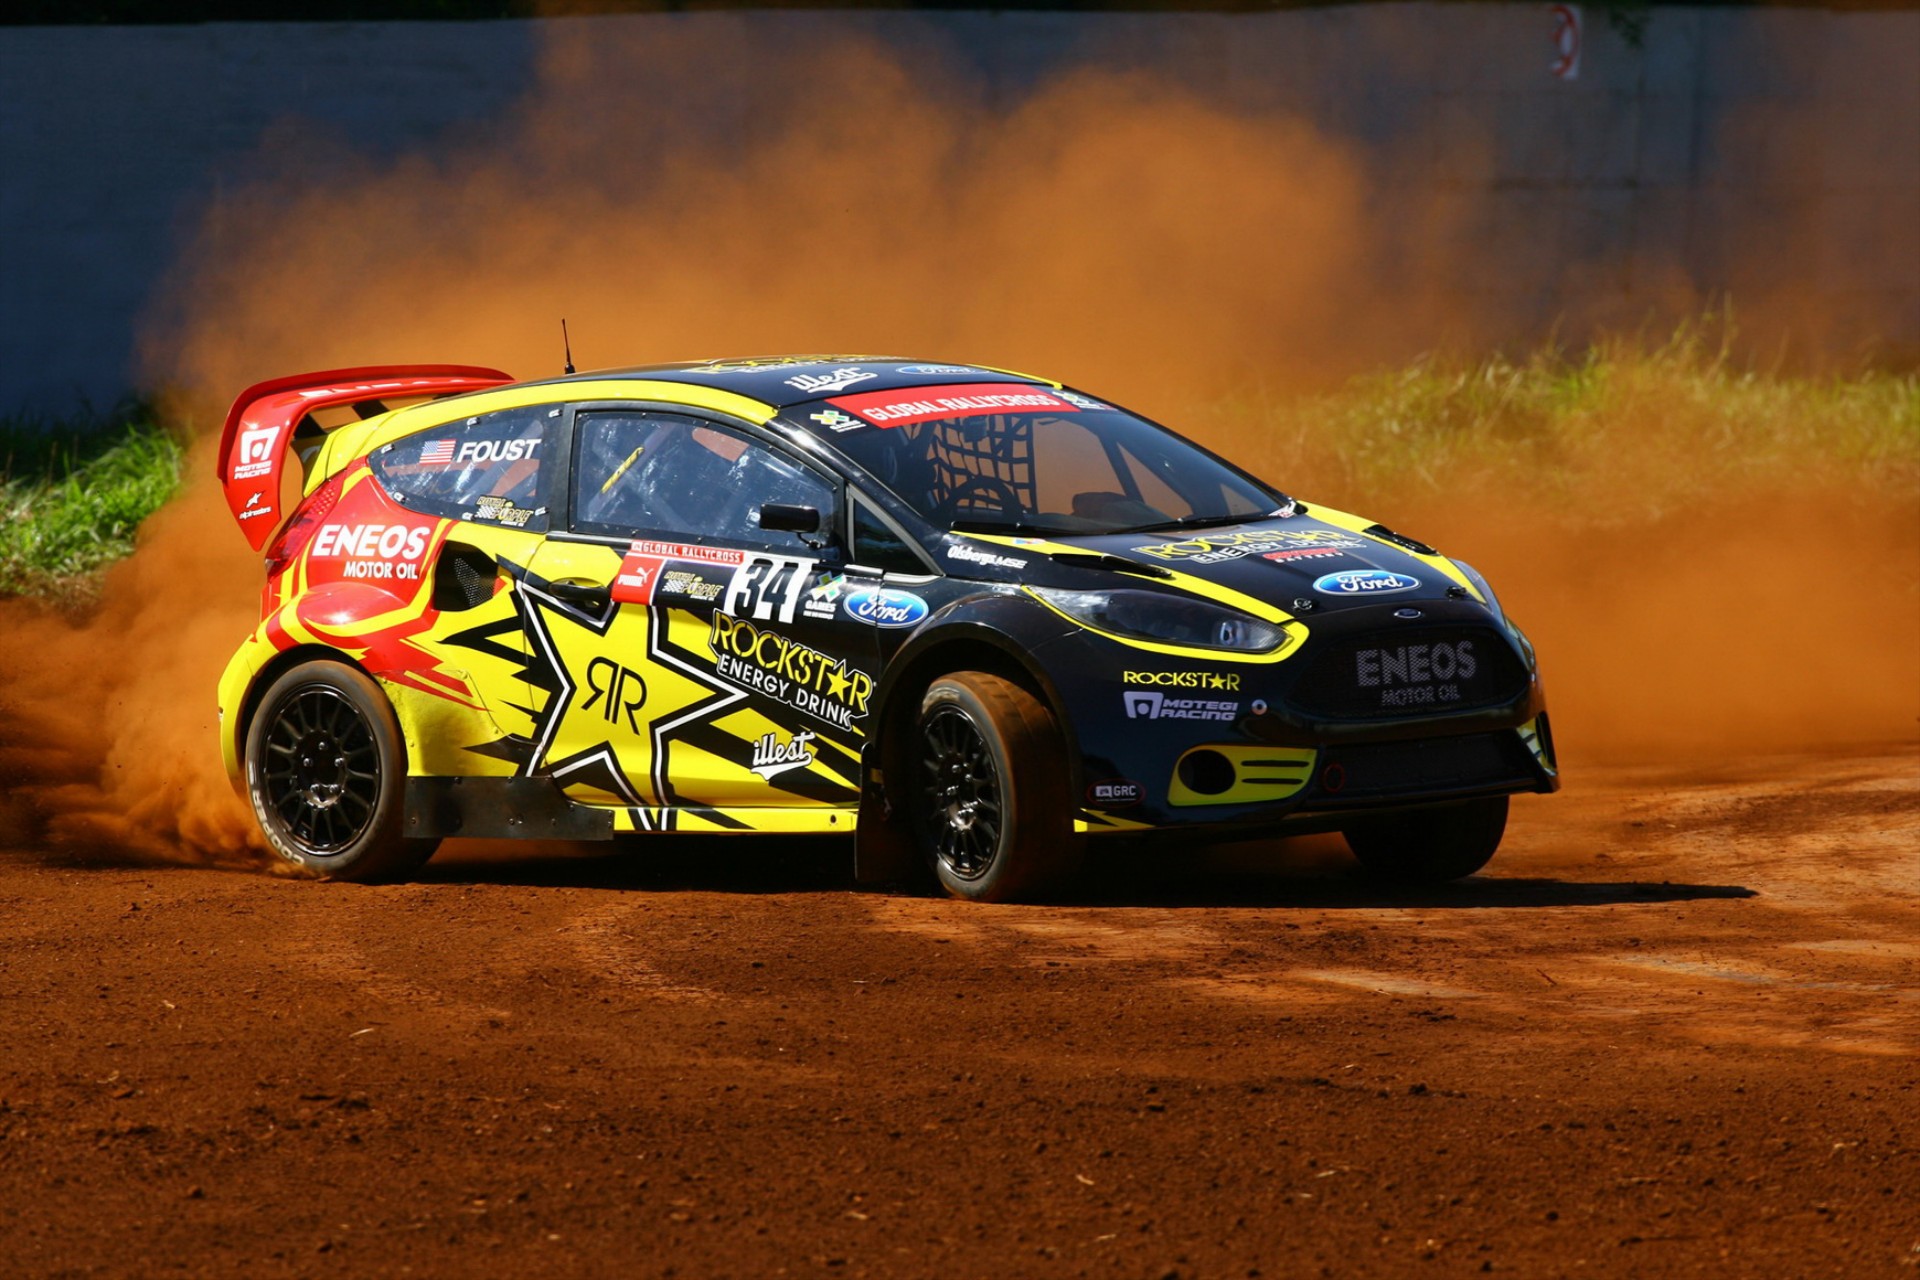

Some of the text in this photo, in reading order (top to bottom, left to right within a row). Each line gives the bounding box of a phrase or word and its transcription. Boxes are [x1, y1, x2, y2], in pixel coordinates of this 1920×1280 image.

[862, 399, 949, 421] GLOBAL
[942, 394, 1060, 411] RALLYCROSS
[456, 438, 542, 463] FOUST
[311, 524, 431, 560] ENEOS
[641, 542, 741, 563] GLOBAL RALLYCROSS
[343, 561, 418, 580] MOTOR OIL
[1335, 573, 1404, 592] Ford
[734, 558, 800, 622] 34
[858, 590, 913, 622] Ford
[1356, 640, 1477, 687] ENEOS
[719, 653, 851, 728] ENERGY DRINK
[1381, 684, 1460, 706] MOTOR OIL
[1163, 699, 1239, 712] MOTEGI
[750, 731, 816, 780] illest
[1113, 785, 1137, 797] GRC
